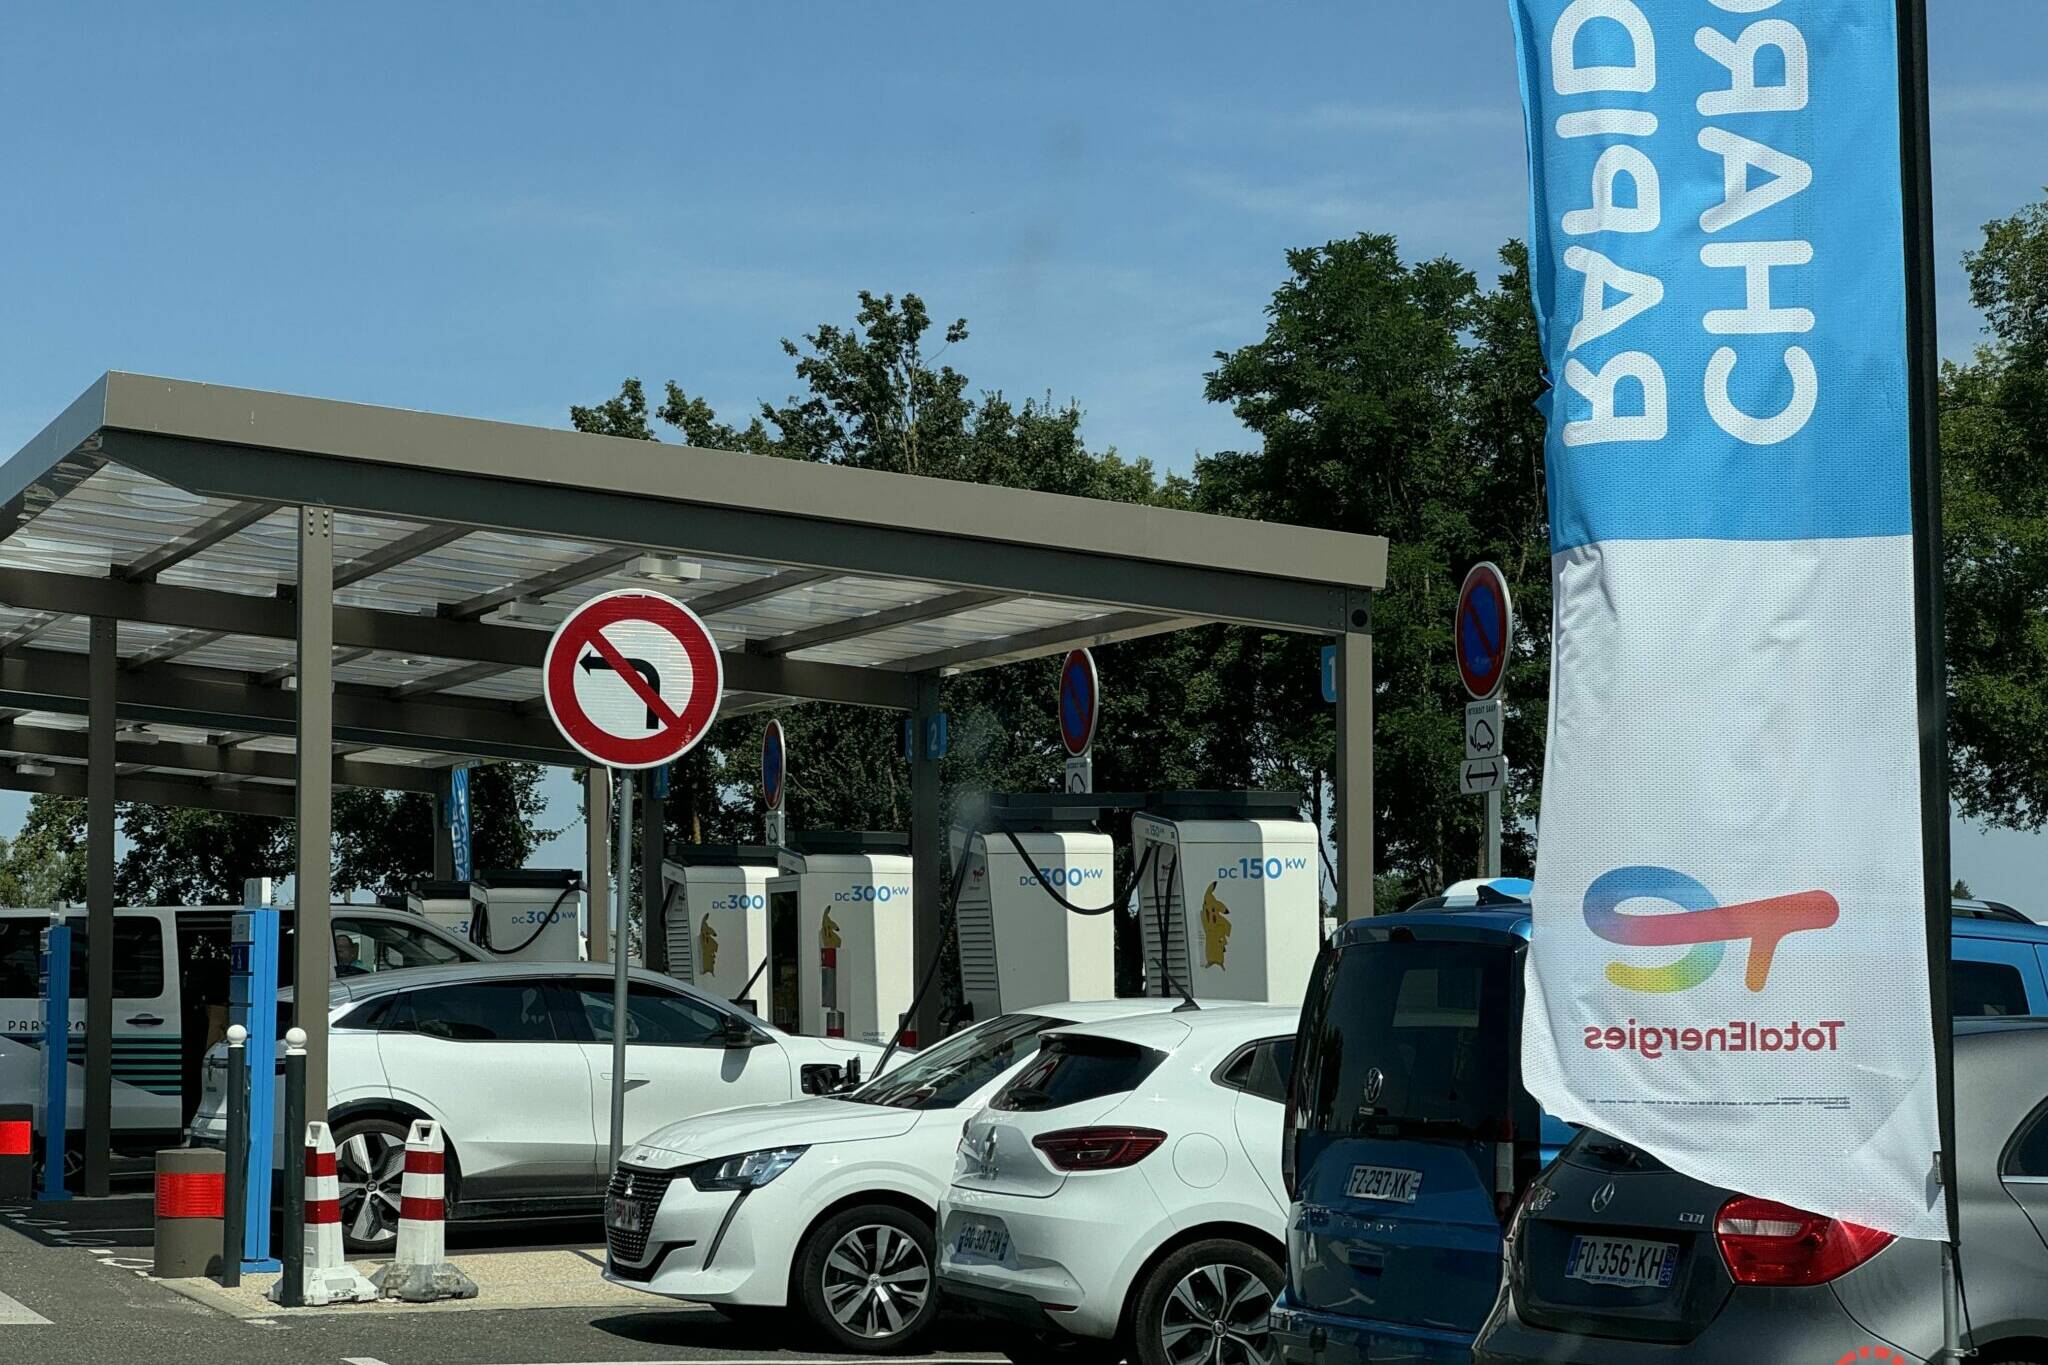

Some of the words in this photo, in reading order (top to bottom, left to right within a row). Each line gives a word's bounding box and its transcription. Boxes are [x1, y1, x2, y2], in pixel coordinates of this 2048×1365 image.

[930, 722, 938, 751] 2
[1084, 869, 1103, 879] kW
[1218, 867, 1238, 879] DC
[1239, 857, 1282, 879] 150
[1284, 857, 1307, 869] kW
[851, 885, 891, 901] 300
[892, 886, 909, 896] kW
[727, 894, 764, 910] 300
[526, 911, 560, 924] 300
